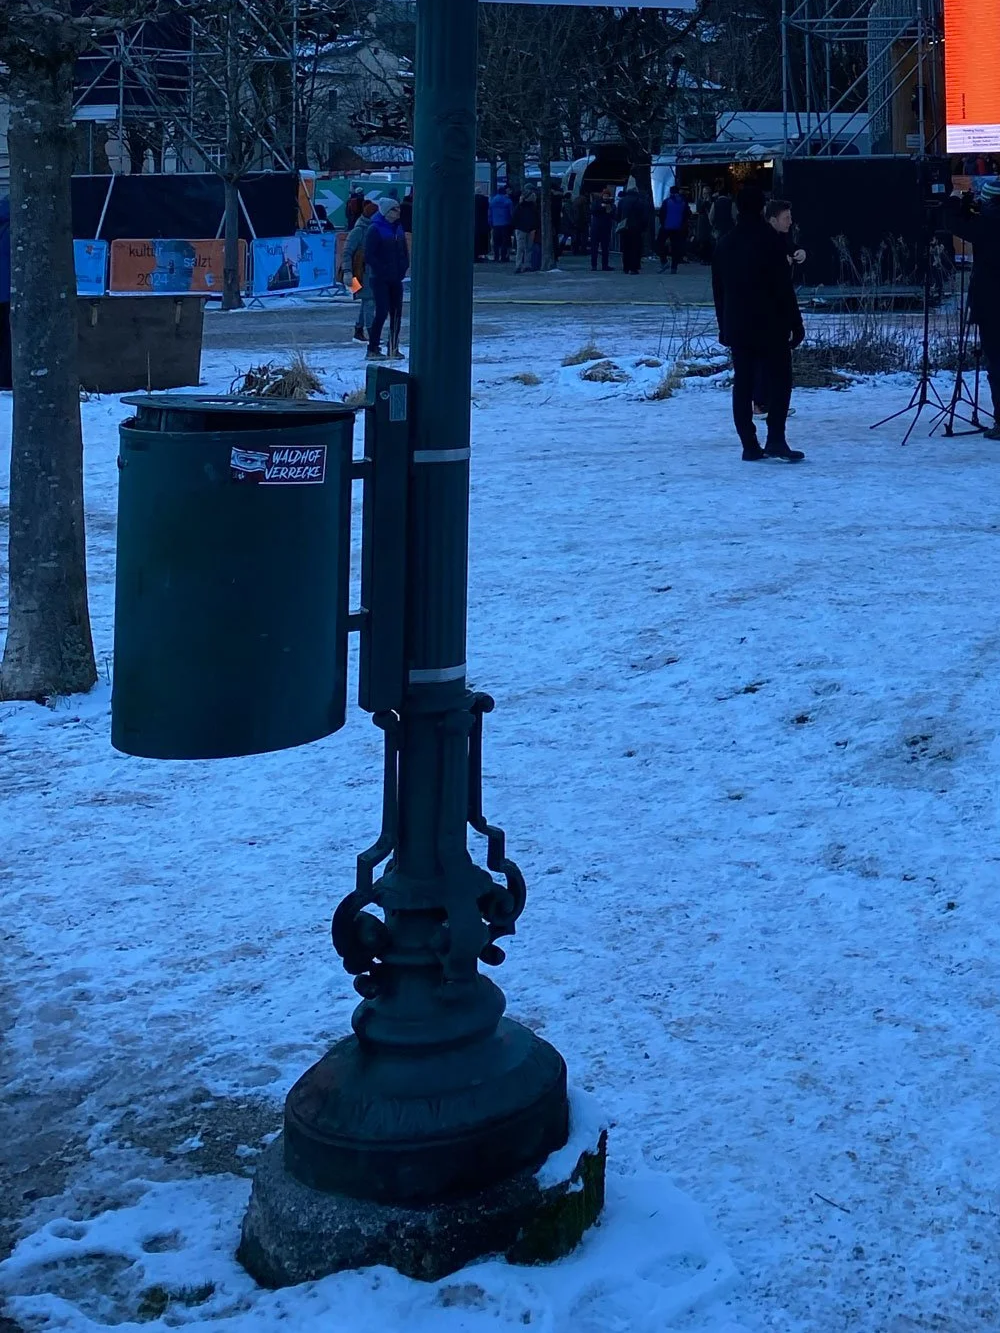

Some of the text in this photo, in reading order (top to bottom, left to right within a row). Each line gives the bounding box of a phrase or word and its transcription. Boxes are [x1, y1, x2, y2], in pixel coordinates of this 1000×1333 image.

[129, 244, 163, 258] kultur
[183, 254, 212, 268] salzt
[136, 273, 169, 286] 2024
[272, 449, 323, 465] WALDHOF
[265, 465, 322, 480] VERRECKE
